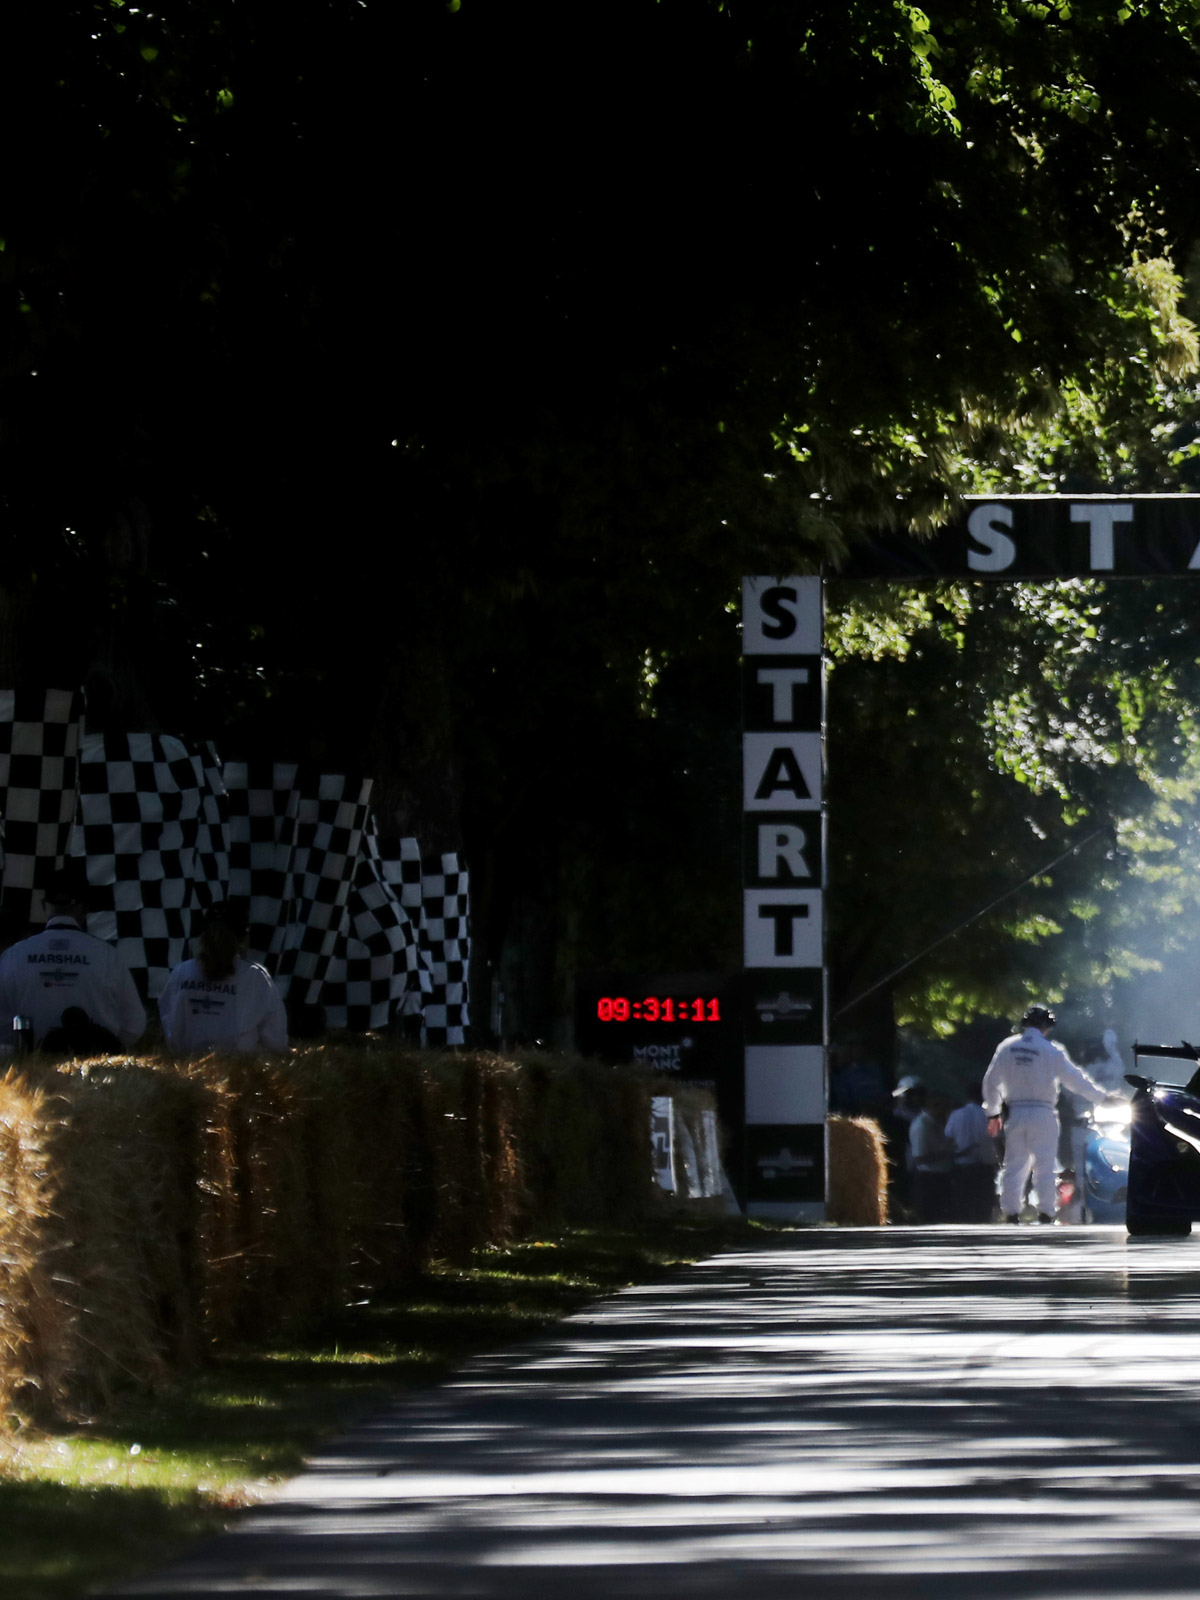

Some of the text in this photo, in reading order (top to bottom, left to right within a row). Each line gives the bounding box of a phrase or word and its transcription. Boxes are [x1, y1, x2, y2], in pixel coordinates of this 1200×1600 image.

[754, 587, 812, 957] START
[27, 953, 91, 966] MARSHAL
[180, 980, 237, 995] MARSHAL
[596, 997, 722, 1022] 09:31:11
[633, 1045, 681, 1057] MONT
[634, 1058, 682, 1071] ANC
